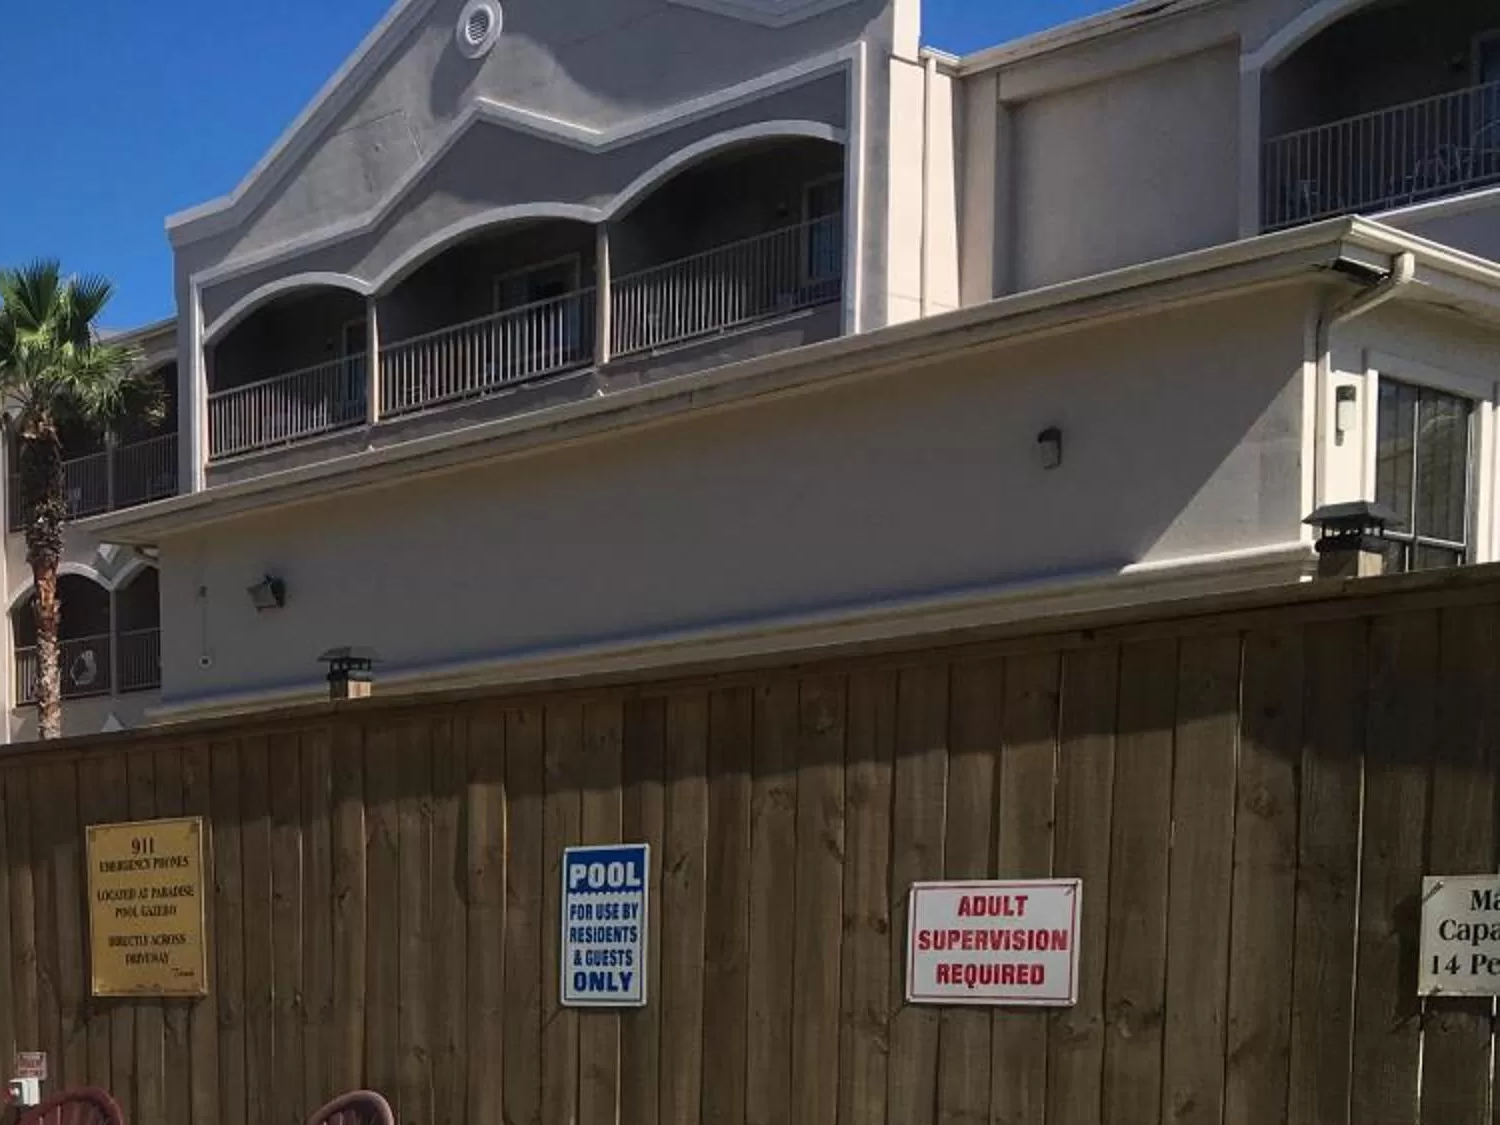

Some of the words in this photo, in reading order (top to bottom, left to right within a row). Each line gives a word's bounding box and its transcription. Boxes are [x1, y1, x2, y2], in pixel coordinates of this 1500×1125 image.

[131, 837, 155, 855] 911
[569, 861, 641, 889] POOL
[569, 903, 594, 921] FOR
[596, 903, 619, 920] USE
[622, 903, 639, 920] BY
[958, 895, 1028, 917] ADULT
[569, 926, 638, 943] RESIDENTS
[918, 929, 1068, 951] SUPERVISION
[574, 950, 583, 966] &
[585, 950, 633, 966] GUESTS
[1432, 953, 1461, 975] 14
[574, 971, 633, 992] ONLY
[936, 963, 1045, 988] REQUIRED
